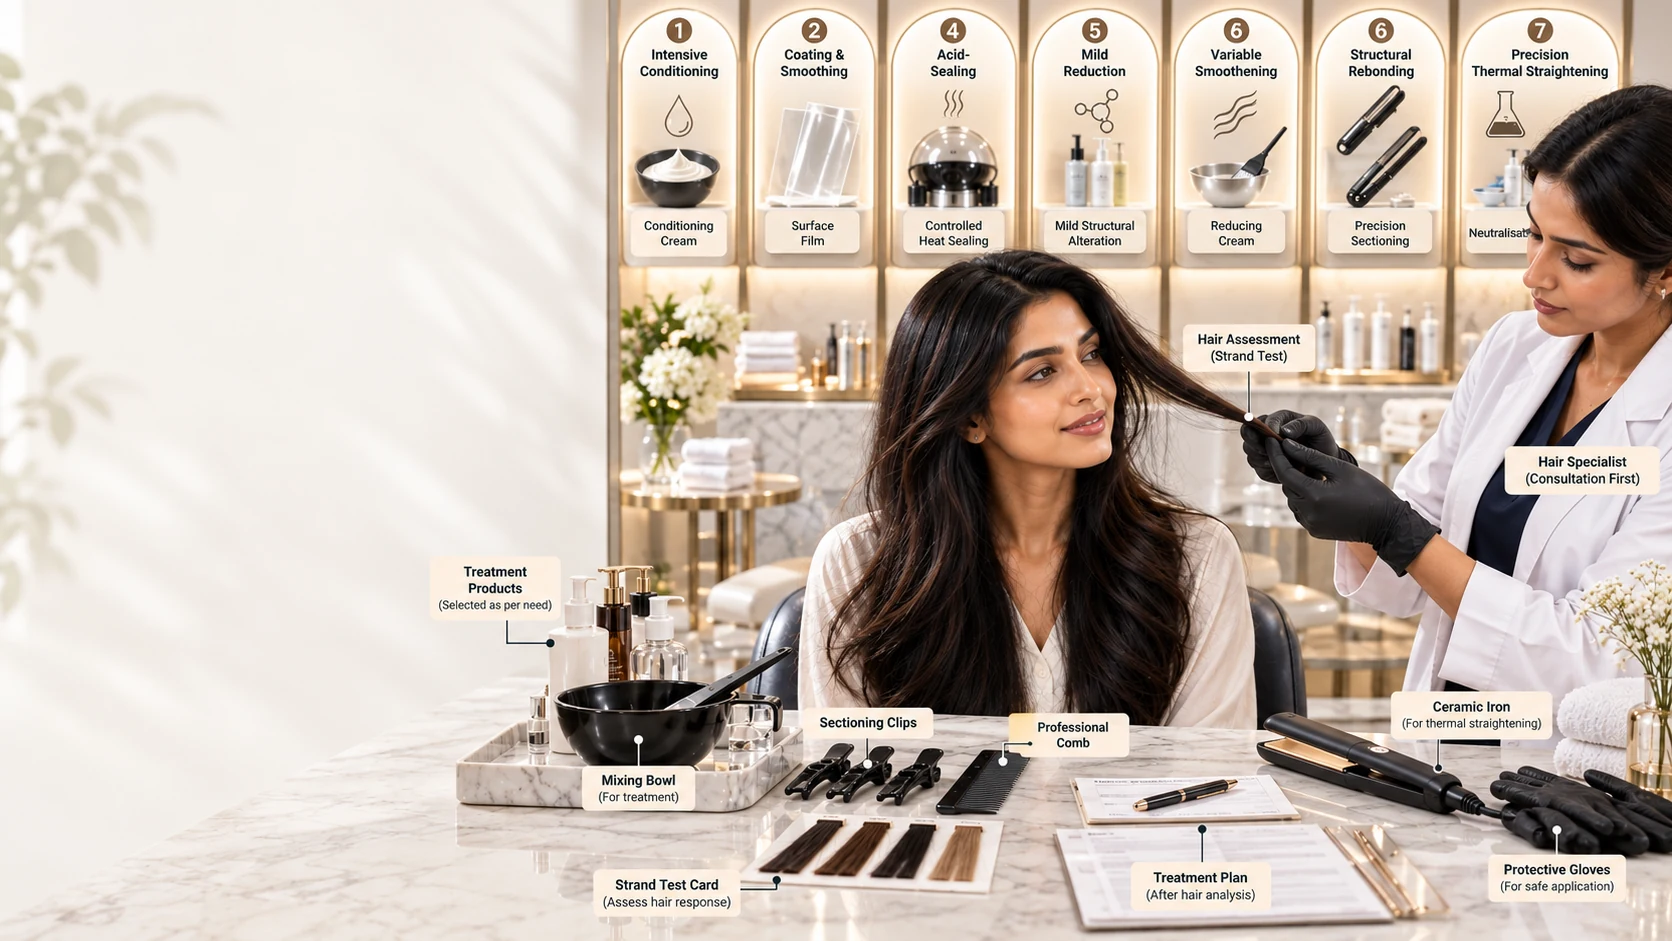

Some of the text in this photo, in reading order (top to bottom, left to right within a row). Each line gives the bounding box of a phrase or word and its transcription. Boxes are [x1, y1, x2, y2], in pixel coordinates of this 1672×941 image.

[674, 22, 682, 39] 1
[808, 22, 821, 39] 2
[946, 22, 960, 39] 4
[1089, 22, 1101, 39] 5
[1230, 22, 1243, 39] 6
[1375, 22, 1387, 39] 6
[1534, 22, 1546, 39] 7
[651, 48, 708, 61] Intensive
[784, 48, 845, 63] Coating &
[936, 48, 971, 61] Acid-
[1081, 48, 1109, 61] Mild
[1210, 48, 1263, 61] Variable
[1350, 48, 1412, 61] Structural
[1511, 48, 1569, 61] Precision
[639, 64, 719, 80] Conditioning
[780, 64, 848, 80] Smoothing
[930, 64, 977, 80] Sealing
[1063, 64, 1126, 77] Reduction
[1194, 64, 1278, 80] Smoothening
[1348, 64, 1415, 80] Rebonding
[1471, 64, 1609, 80] Thermal Straightening
[643, 220, 714, 234] Conditioning
[791, 219, 835, 231] Surface
[925, 219, 983, 231] Controlled
[1055, 219, 1135, 231] Mild Structural
[1210, 219, 1263, 234] Reducing
[1354, 220, 1406, 231] Precision
[1468, 227, 1529, 238] Neutralisat
[660, 235, 698, 247] Cream
[801, 235, 825, 247] Film
[919, 235, 989, 249] Heat Sealing
[1067, 235, 1122, 247] Alteration
[1218, 235, 1255, 247] Cream
[1350, 235, 1410, 249] Sectioning
